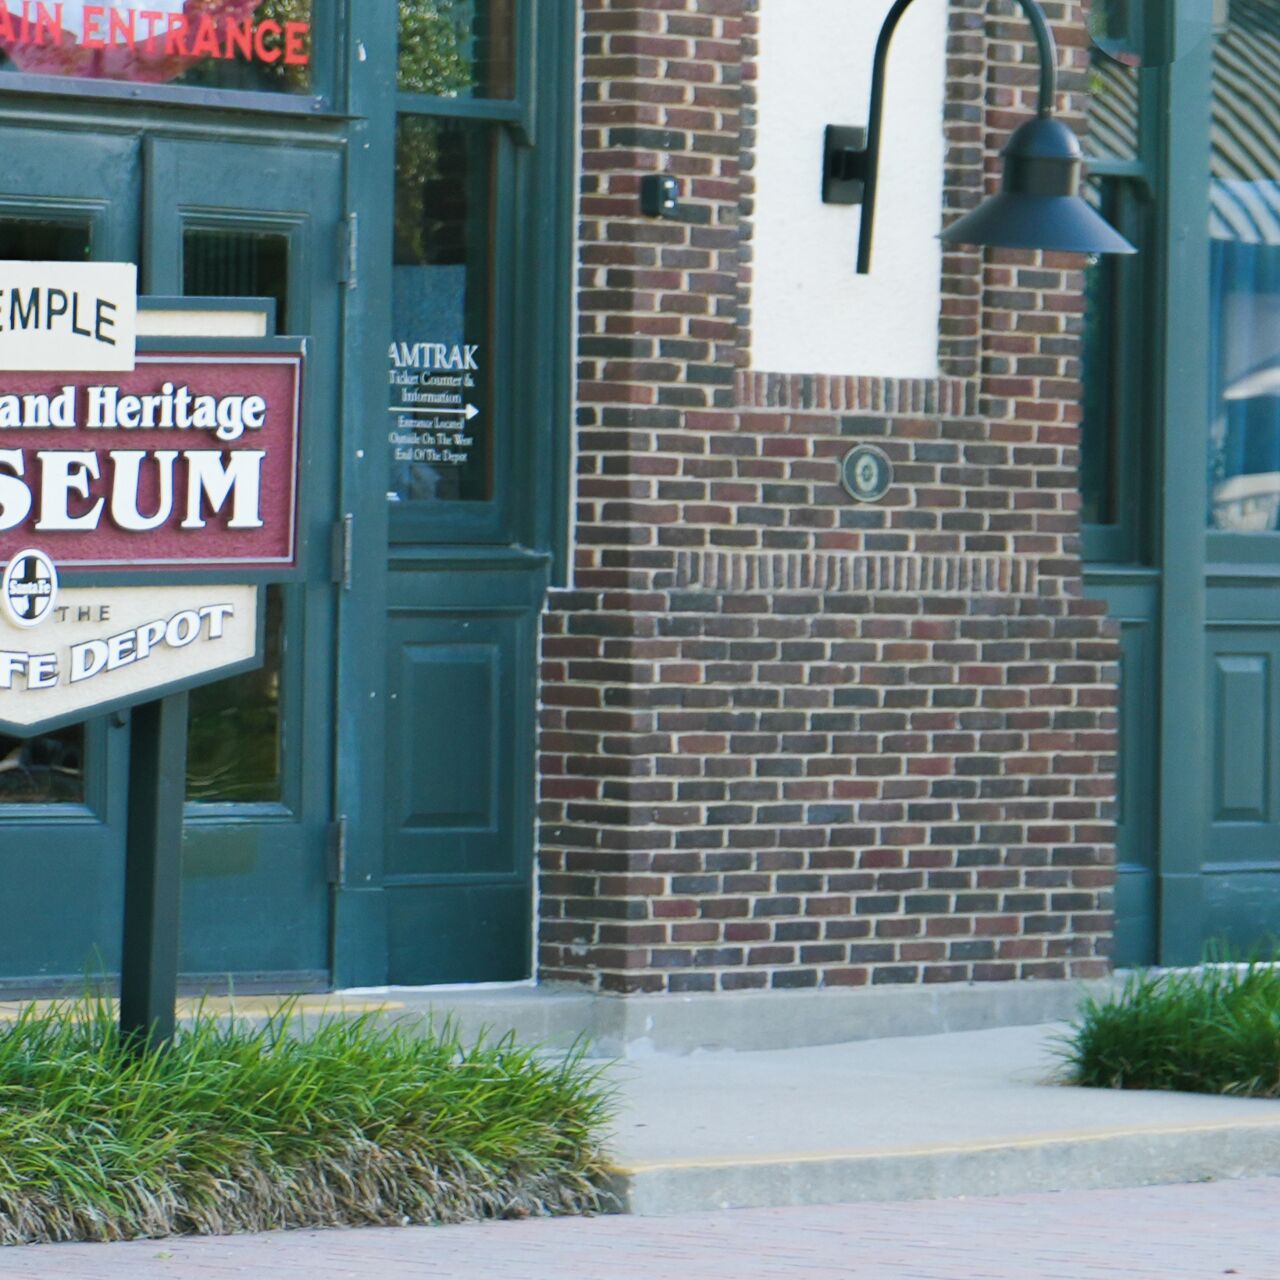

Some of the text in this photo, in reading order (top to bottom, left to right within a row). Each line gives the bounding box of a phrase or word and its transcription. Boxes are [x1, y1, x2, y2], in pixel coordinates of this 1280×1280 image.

[81, 5, 310, 65] ENTRANCE
[388, 342, 479, 370] AMTRAK
[389, 370, 419, 385] Ticket
[421, 372, 462, 387] Counter
[401, 387, 462, 404] Information
[86, 383, 267, 440] Heritage
[54, 605, 111, 623] THE
[69, 603, 234, 684] DEPOT
